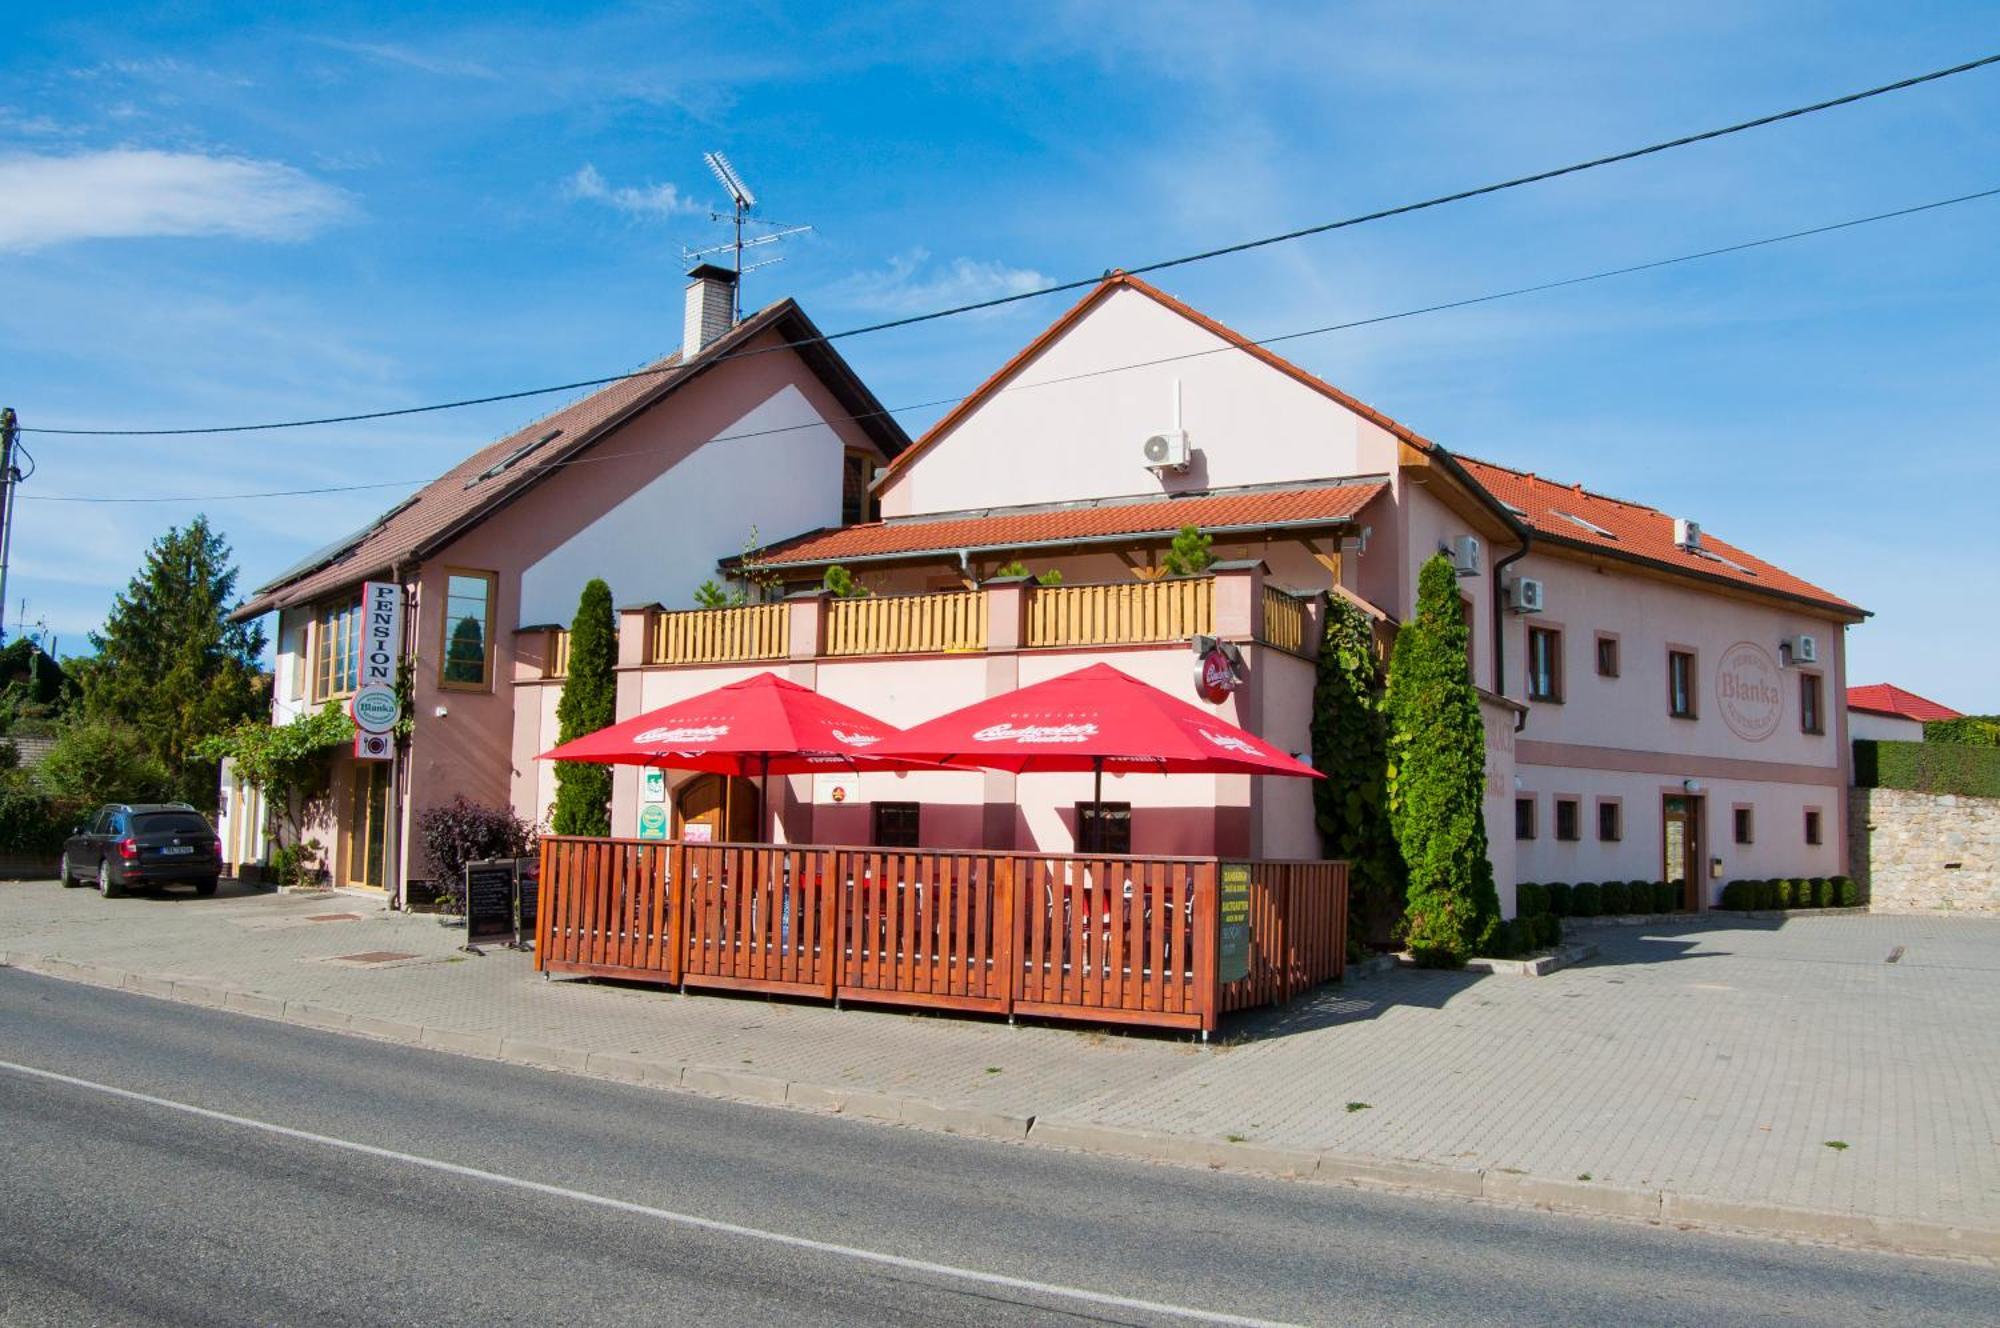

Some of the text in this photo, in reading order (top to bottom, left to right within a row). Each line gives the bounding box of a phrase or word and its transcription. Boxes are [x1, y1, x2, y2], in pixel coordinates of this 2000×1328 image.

[370, 587, 394, 678] PENSION
[1722, 672, 1779, 705] Blanka
[360, 703, 394, 713] Blanka
